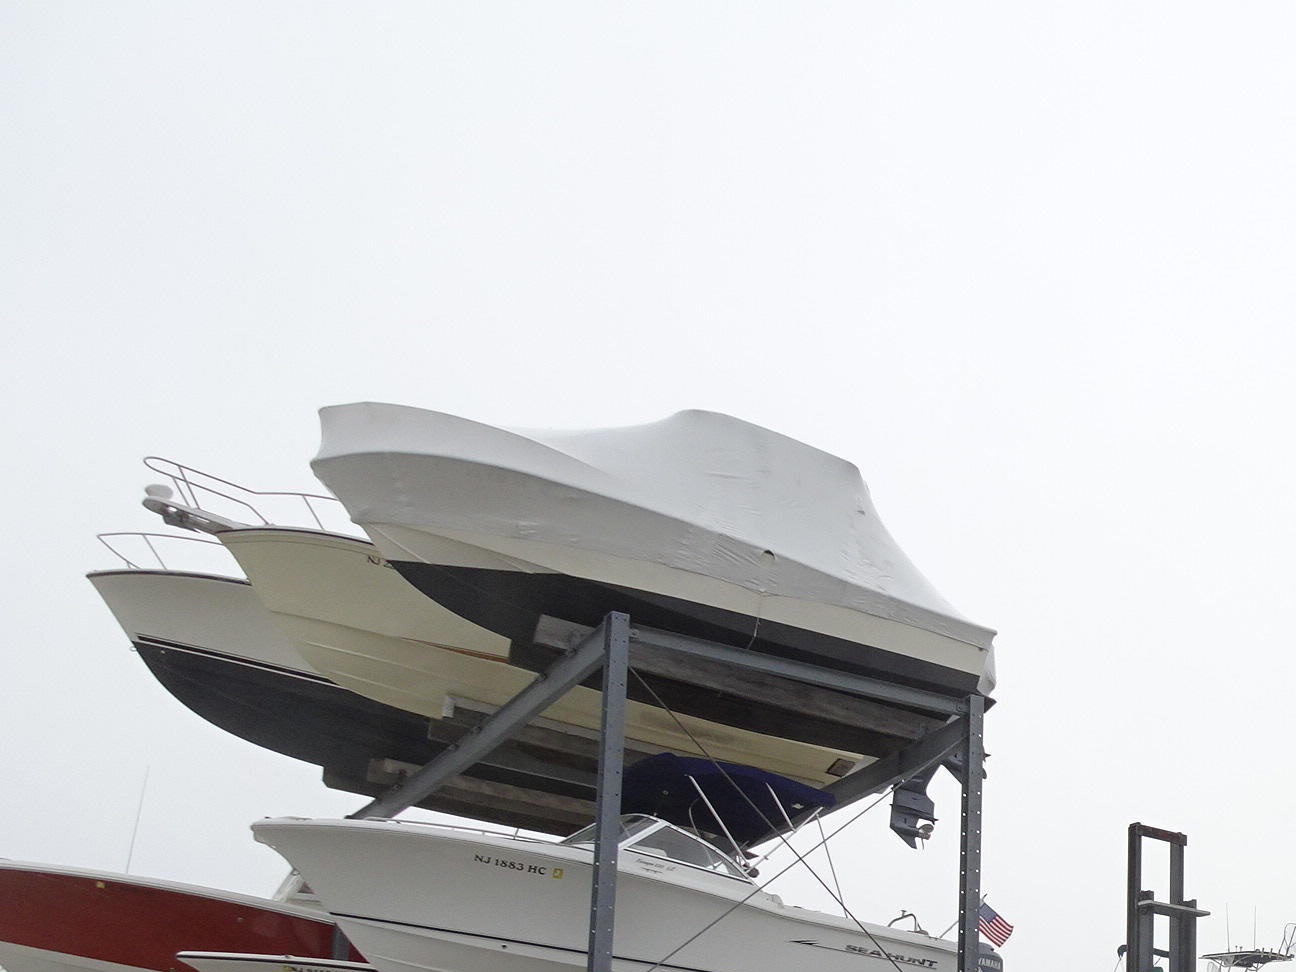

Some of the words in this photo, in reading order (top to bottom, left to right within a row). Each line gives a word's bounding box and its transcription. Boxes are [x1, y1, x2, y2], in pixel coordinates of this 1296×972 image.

[474, 854, 491, 865] NJ
[495, 858, 525, 872] 1883
[527, 864, 547, 876] HC
[845, 944, 882, 957] SEA
[888, 952, 938, 968] HUNT
